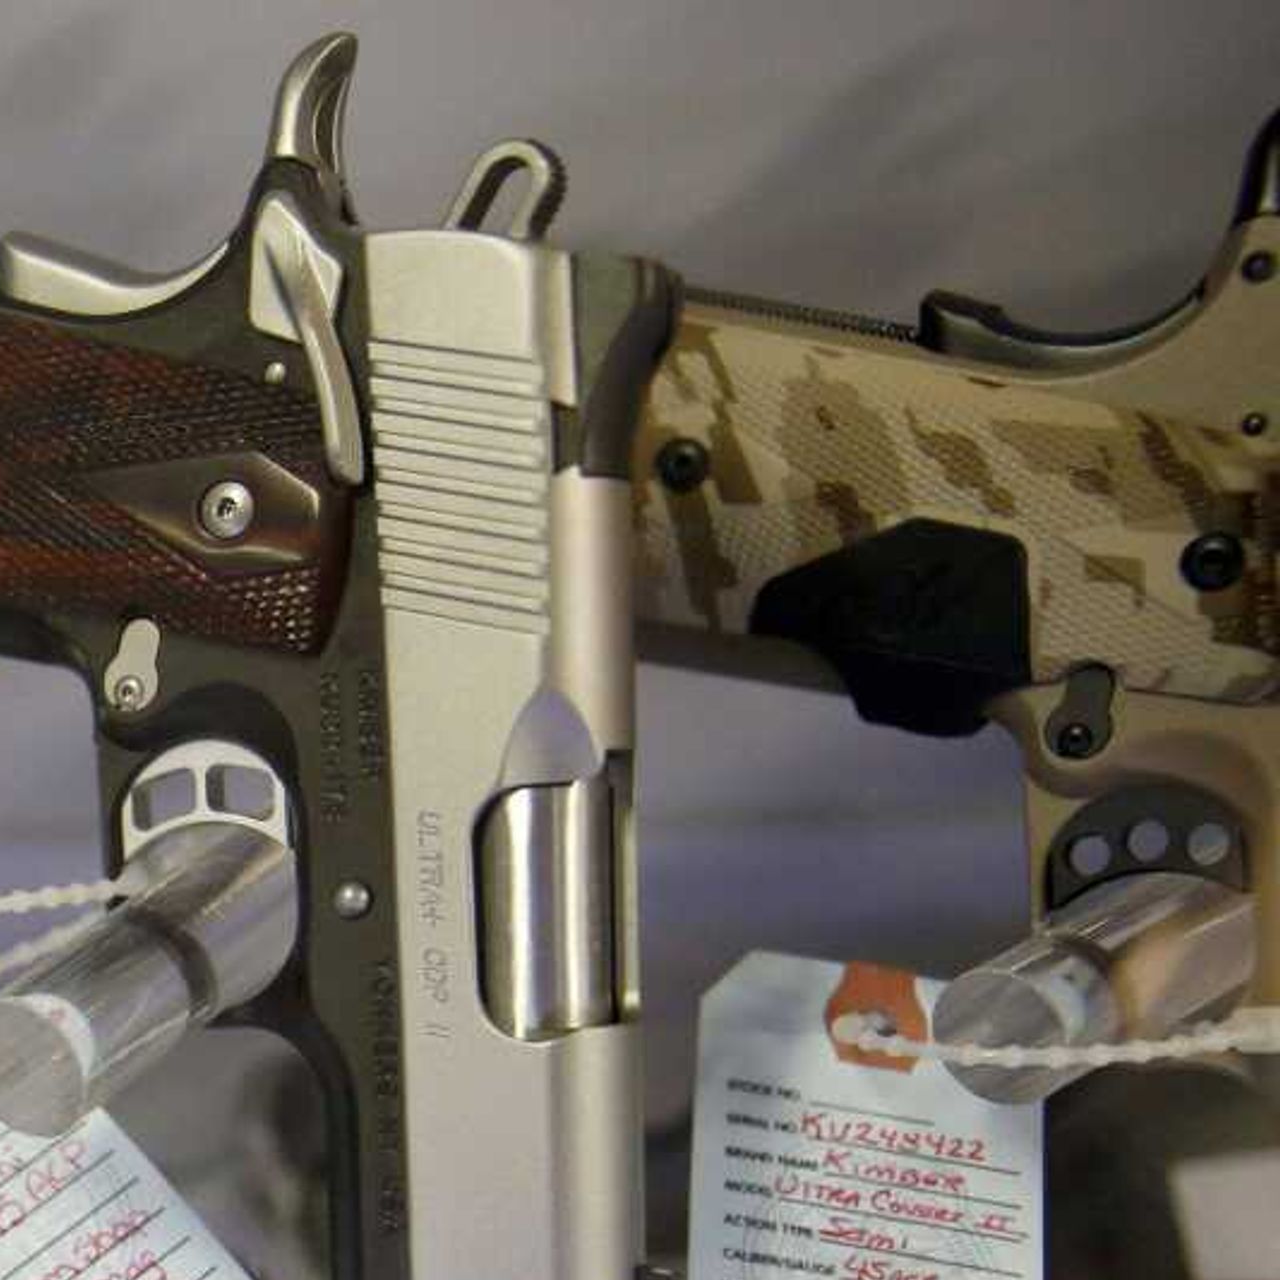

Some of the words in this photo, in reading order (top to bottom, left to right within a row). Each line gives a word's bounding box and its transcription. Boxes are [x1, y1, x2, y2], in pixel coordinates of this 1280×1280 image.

[19, 1134, 96, 1203] ACP
[723, 1213, 777, 1233] ACTION
[781, 1220, 814, 1239] TYPE
